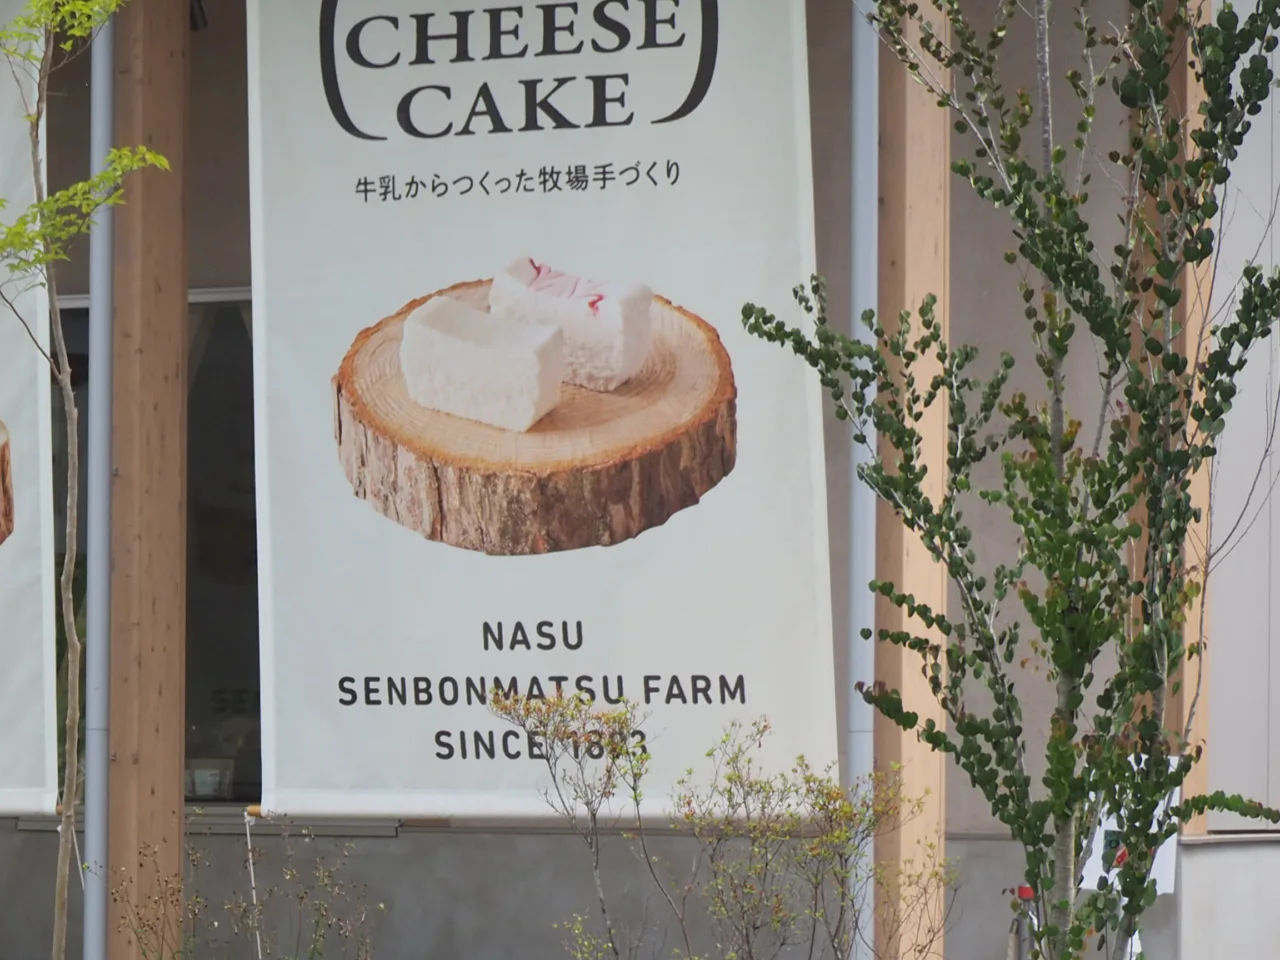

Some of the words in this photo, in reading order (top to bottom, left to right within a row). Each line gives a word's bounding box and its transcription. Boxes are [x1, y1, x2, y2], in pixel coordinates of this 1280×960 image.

[345, 0, 686, 69] CHEESE
[396, 73, 635, 139] CAKE
[355, 159, 681, 203] 牛乳からつくった牧場手づくり
[482, 620, 584, 651] NASU
[338, 674, 624, 706] SENBONMATSU
[644, 674, 747, 705] FARM
[434, 730, 549, 760] SINCE
